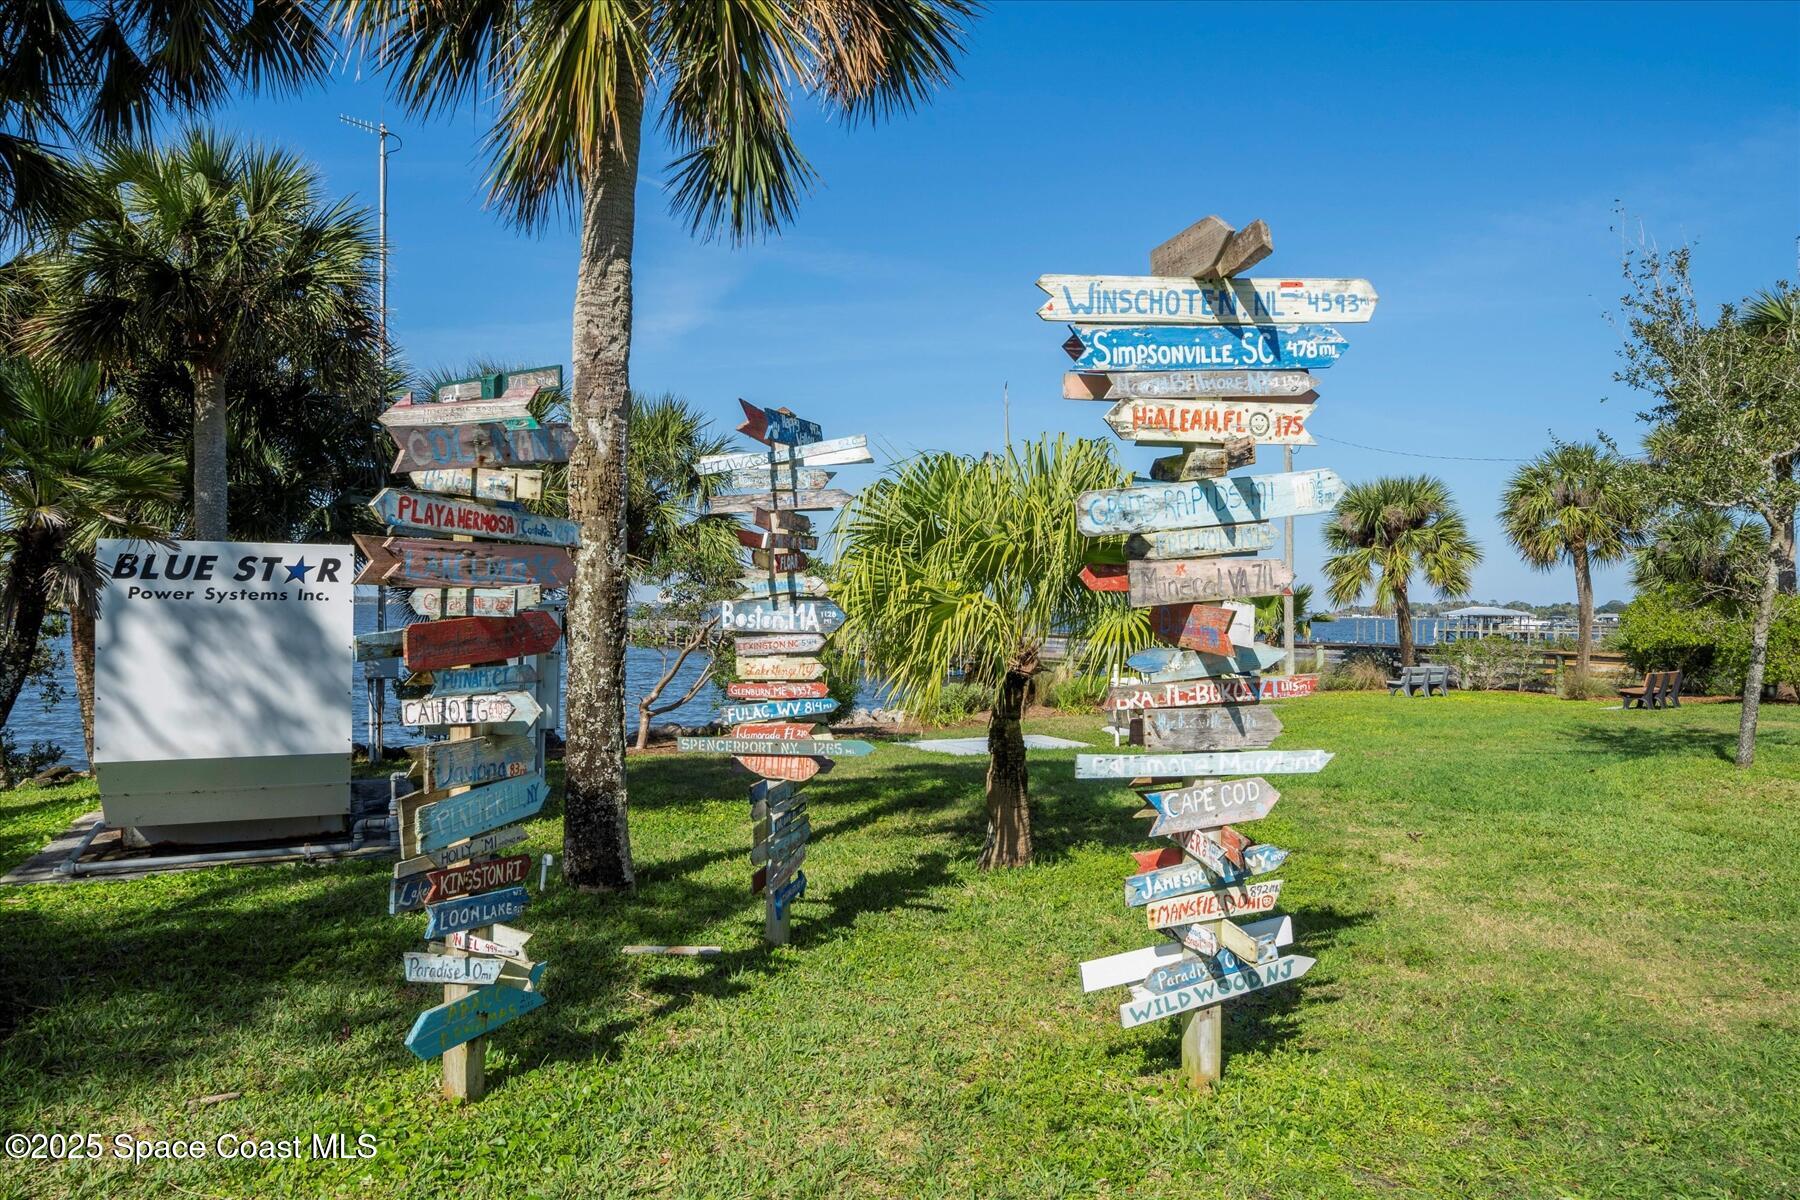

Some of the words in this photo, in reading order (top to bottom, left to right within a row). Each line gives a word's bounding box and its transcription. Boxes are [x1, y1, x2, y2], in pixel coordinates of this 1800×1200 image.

[1255, 294, 1285, 317] NL
[1307, 292, 1359, 313] 4593
[1242, 332, 1273, 361] SC
[1287, 342, 1316, 359] 478
[1275, 414, 1304, 437] 175
[398, 495, 456, 527] PLAYA
[457, 506, 515, 534] HERMOSA
[1163, 484, 1243, 521] RAPIDS
[111, 553, 218, 581] BLUE
[127, 586, 194, 600] Power
[205, 587, 288, 604] Systems
[297, 588, 330, 602] Inc.
[1141, 567, 1222, 604] Mineral
[1228, 566, 1250, 595] VA
[789, 603, 820, 633] MA
[787, 640, 799, 648] NC
[730, 685, 771, 697] GLENBURN
[773, 685, 787, 696] ME
[776, 702, 801, 718] WV
[804, 701, 823, 714] 814
[681, 738, 773, 753] SPENCERPORT
[812, 741, 842, 755] 1265
[509, 762, 520, 777] 83
[527, 783, 540, 804] NY
[1164, 787, 1216, 818] CAPE
[1221, 781, 1260, 808] COD
[484, 835, 497, 850] MI
[440, 905, 480, 931] LOON
[483, 901, 513, 921] LAKE
[409, 956, 466, 980] Paradise
[1157, 961, 1215, 990] Paradise
[1266, 960, 1295, 983] NJ
